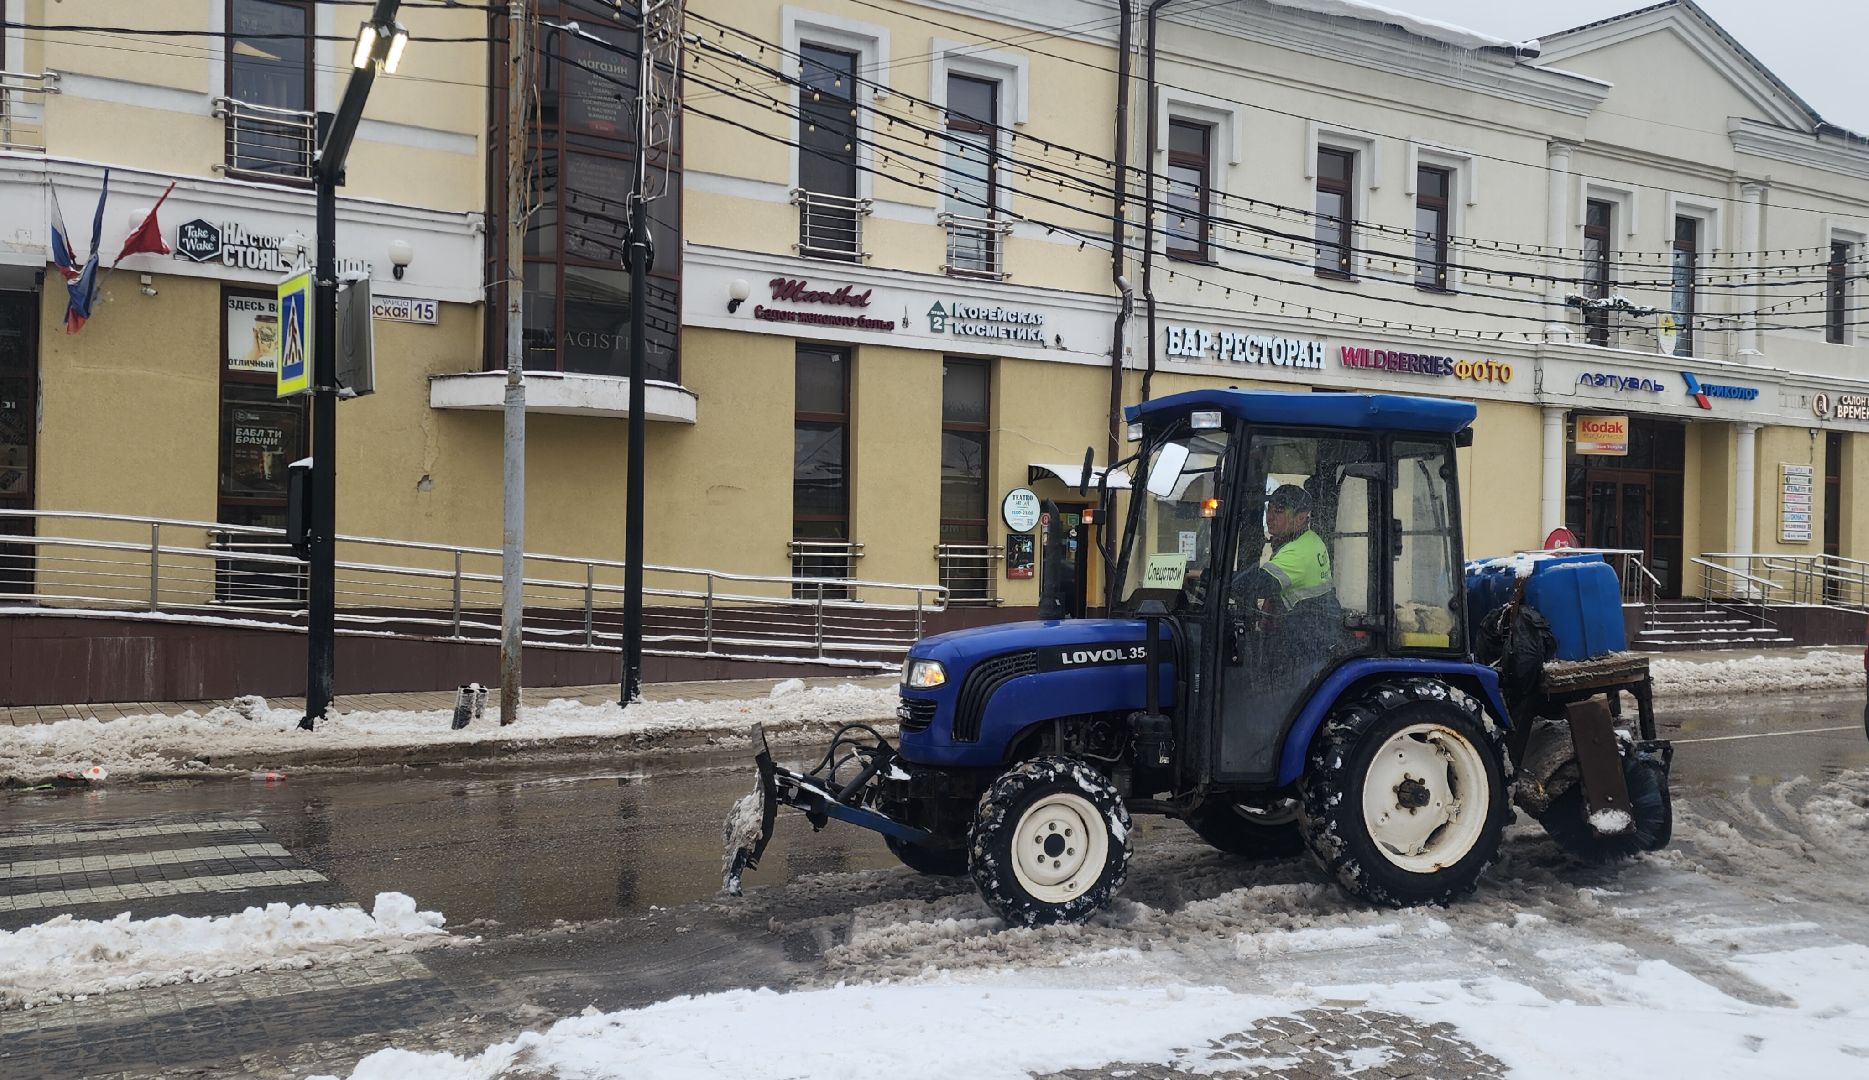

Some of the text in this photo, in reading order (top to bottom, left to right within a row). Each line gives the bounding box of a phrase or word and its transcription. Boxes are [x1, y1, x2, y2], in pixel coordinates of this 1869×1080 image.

[185, 225, 209, 238] Take
[182, 238, 215, 251] Wake
[228, 299, 265, 312] ЗДЕСЬ
[414, 303, 434, 320] 15
[953, 302, 1046, 326] КОРЕЙСКАЯ
[933, 316, 943, 330] 2
[953, 322, 1046, 342] КОСМЕТИКА
[1340, 346, 1454, 377] WILDBERRIES
[1455, 360, 1513, 384] ФОТО
[1701, 384, 1760, 401] ТРИКОЛОР
[235, 427, 282, 438] БАБЛ ТИ
[1581, 421, 1624, 433] Kodak
[235, 436, 278, 445] БРАУНИ
[1061, 648, 1127, 665] LOVOL
